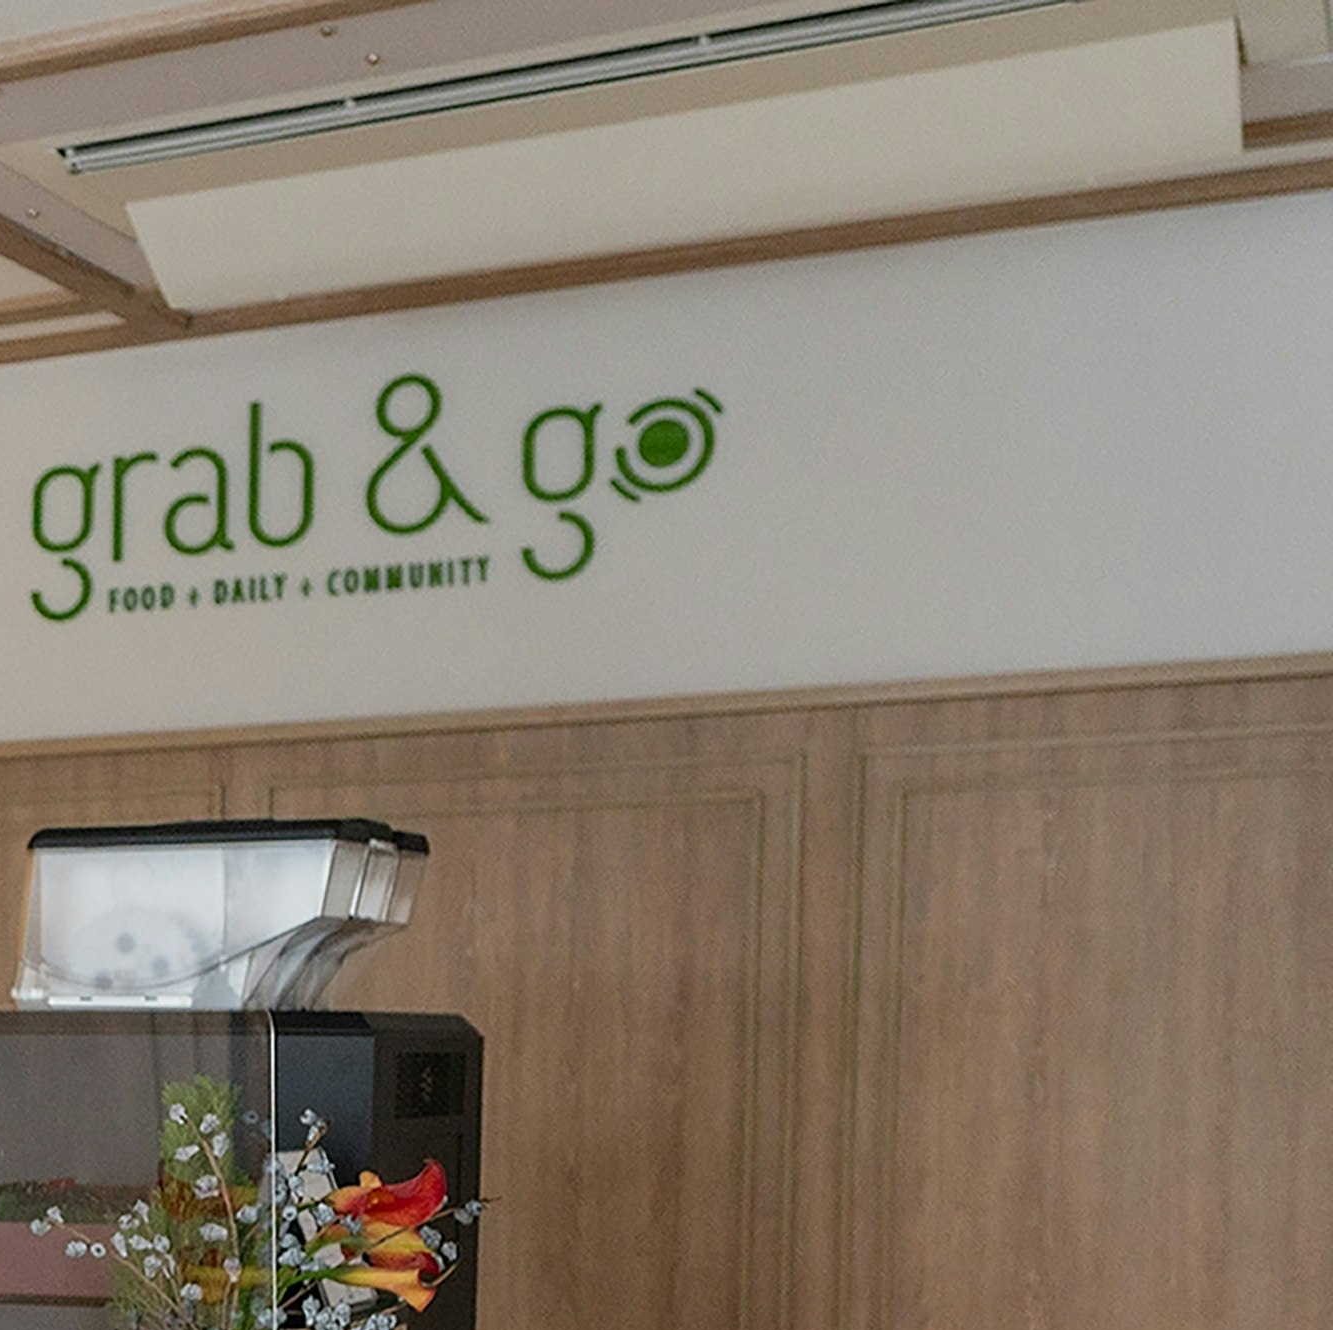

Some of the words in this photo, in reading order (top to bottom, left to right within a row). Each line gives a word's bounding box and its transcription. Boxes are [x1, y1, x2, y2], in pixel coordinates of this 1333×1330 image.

[31, 401, 315, 622] grab
[366, 372, 489, 535] &
[521, 387, 724, 581] go
[108, 585, 176, 614] FOOD
[213, 572, 289, 606] DAILY
[327, 555, 491, 598] COMMUNITY
